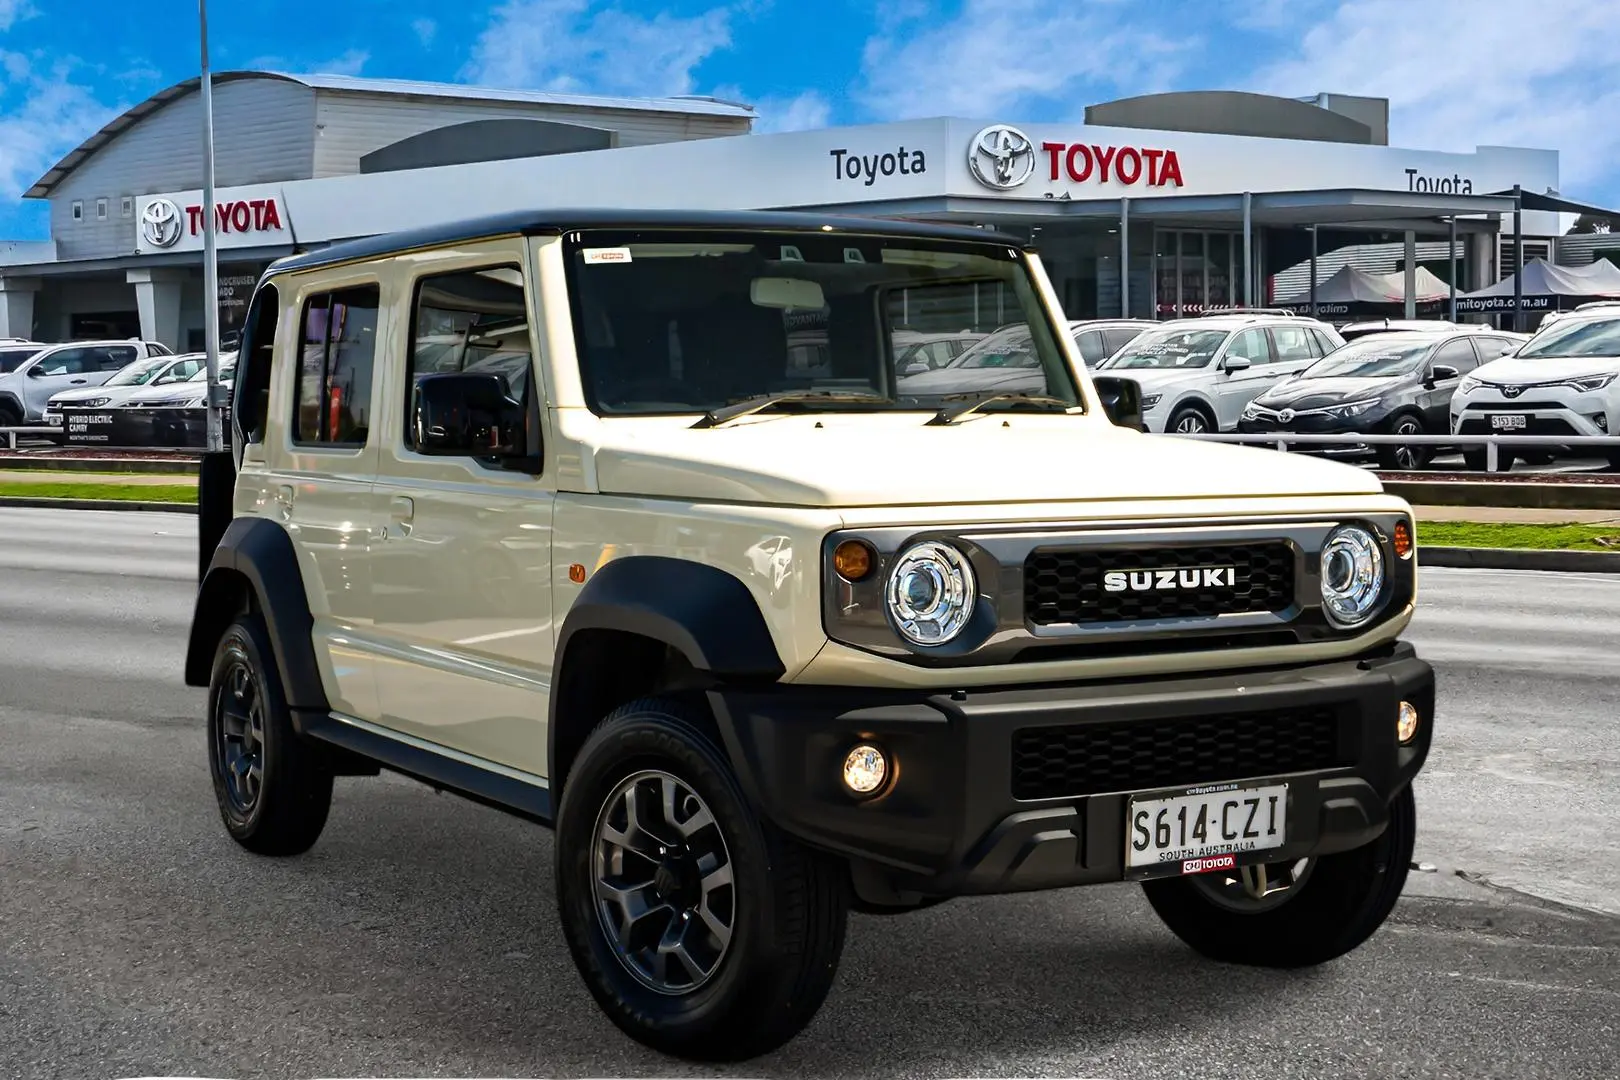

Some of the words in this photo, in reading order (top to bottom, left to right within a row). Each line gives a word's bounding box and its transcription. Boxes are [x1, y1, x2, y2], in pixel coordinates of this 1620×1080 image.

[830, 146, 926, 187] Toyota
[1042, 142, 1184, 187] TOYOTA
[1405, 168, 1472, 195] Toyota
[68, 415, 88, 424] HYBRID
[89, 415, 113, 424] ELECTRIC
[1104, 568, 1235, 592] SUZUKI
[1159, 848, 1195, 862] SOUTH
[1199, 841, 1256, 857] AUSTRALIA
